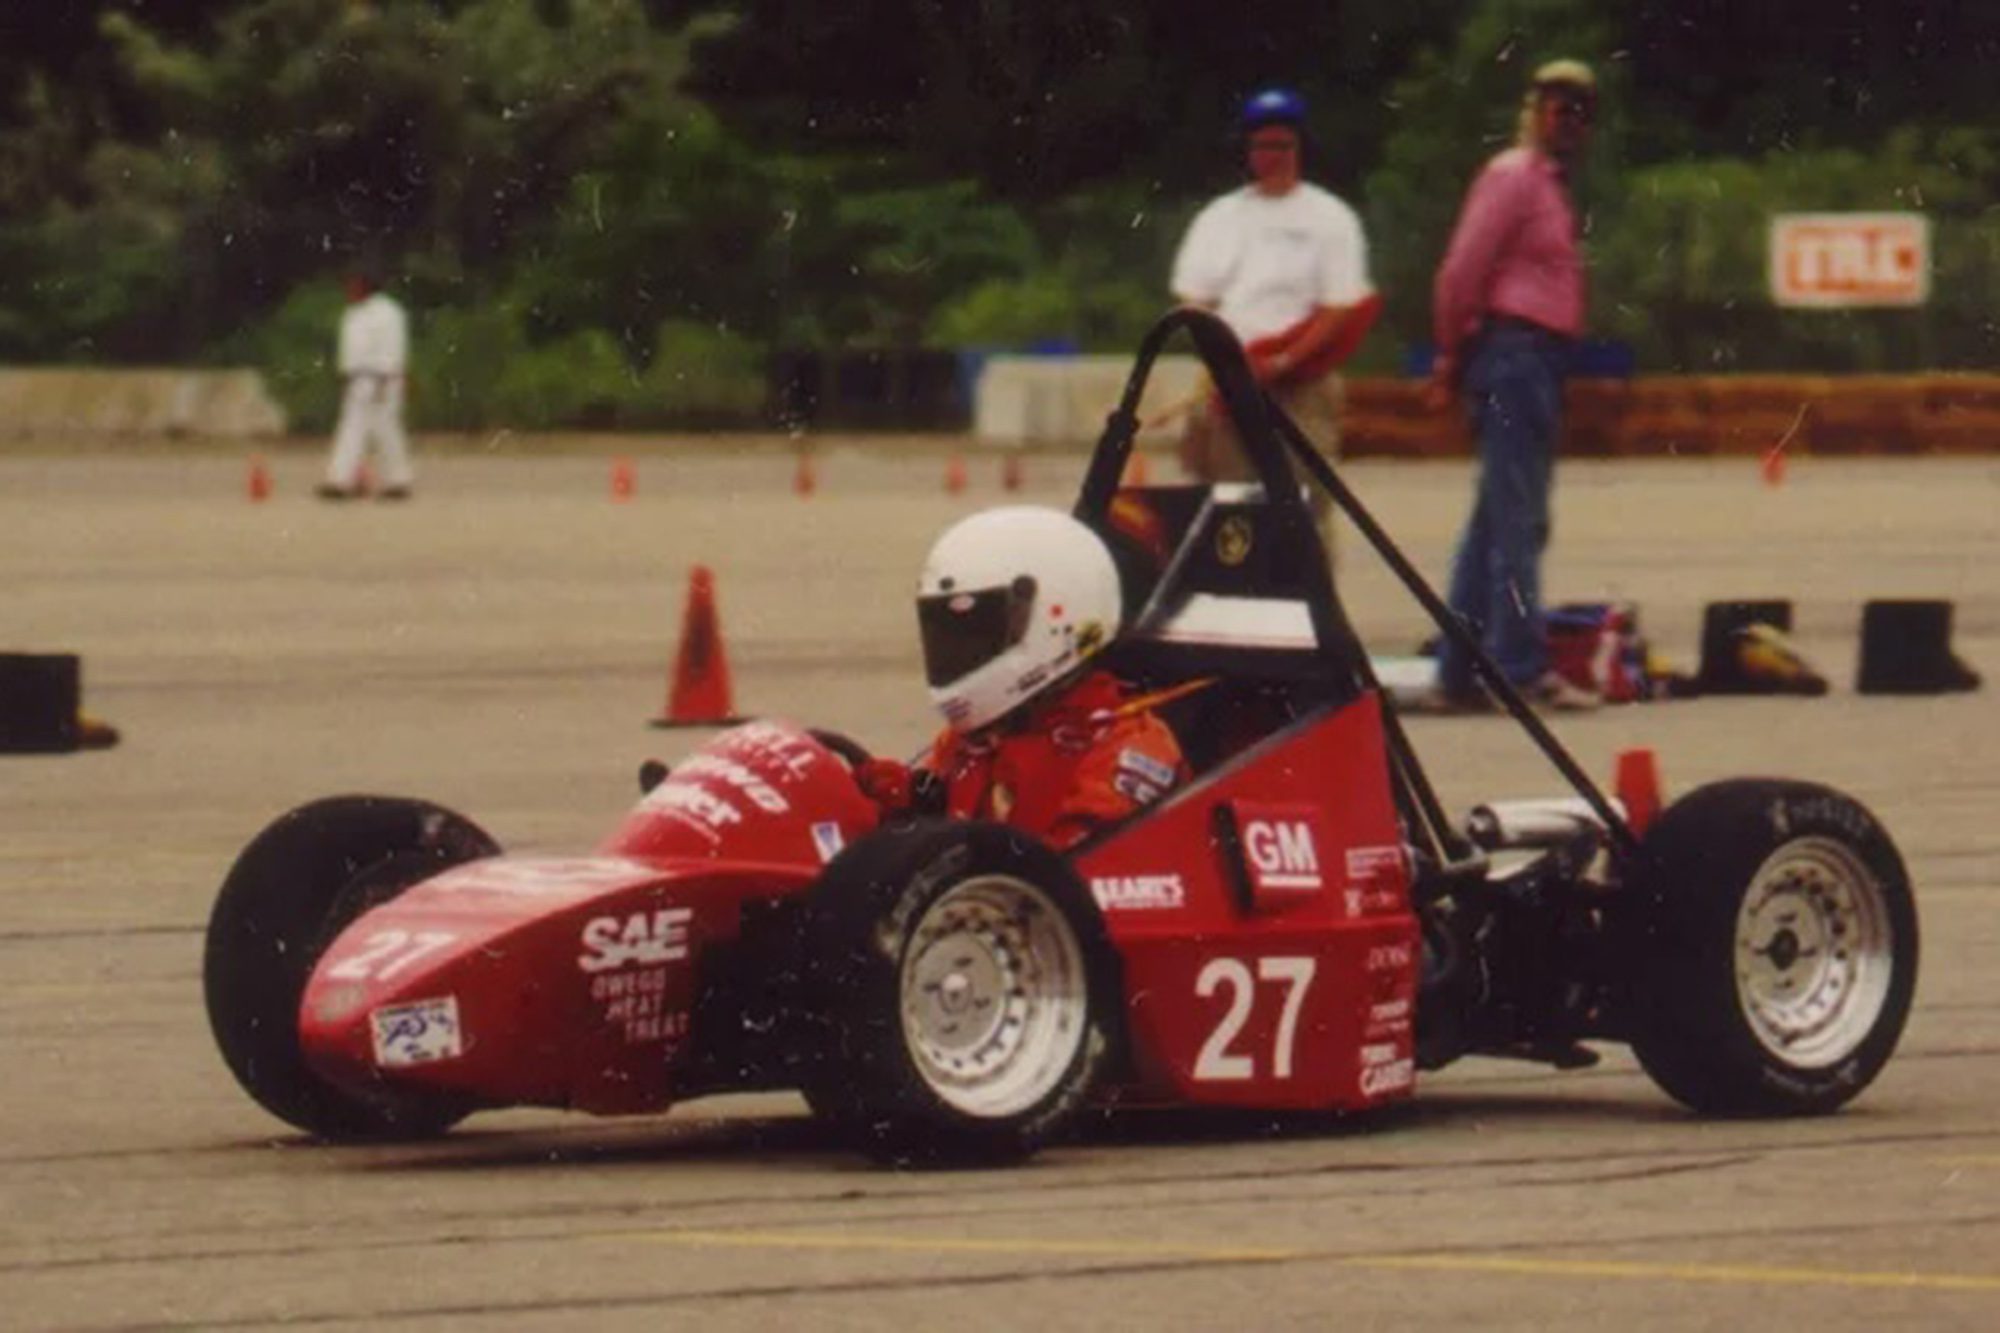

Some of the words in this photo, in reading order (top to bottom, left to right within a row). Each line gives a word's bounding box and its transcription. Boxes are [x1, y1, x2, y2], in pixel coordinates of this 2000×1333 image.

[1246, 820, 1318, 874] GM
[327, 931, 459, 983] 27
[578, 907, 693, 972] SAE
[1193, 956, 1317, 1081] 27
